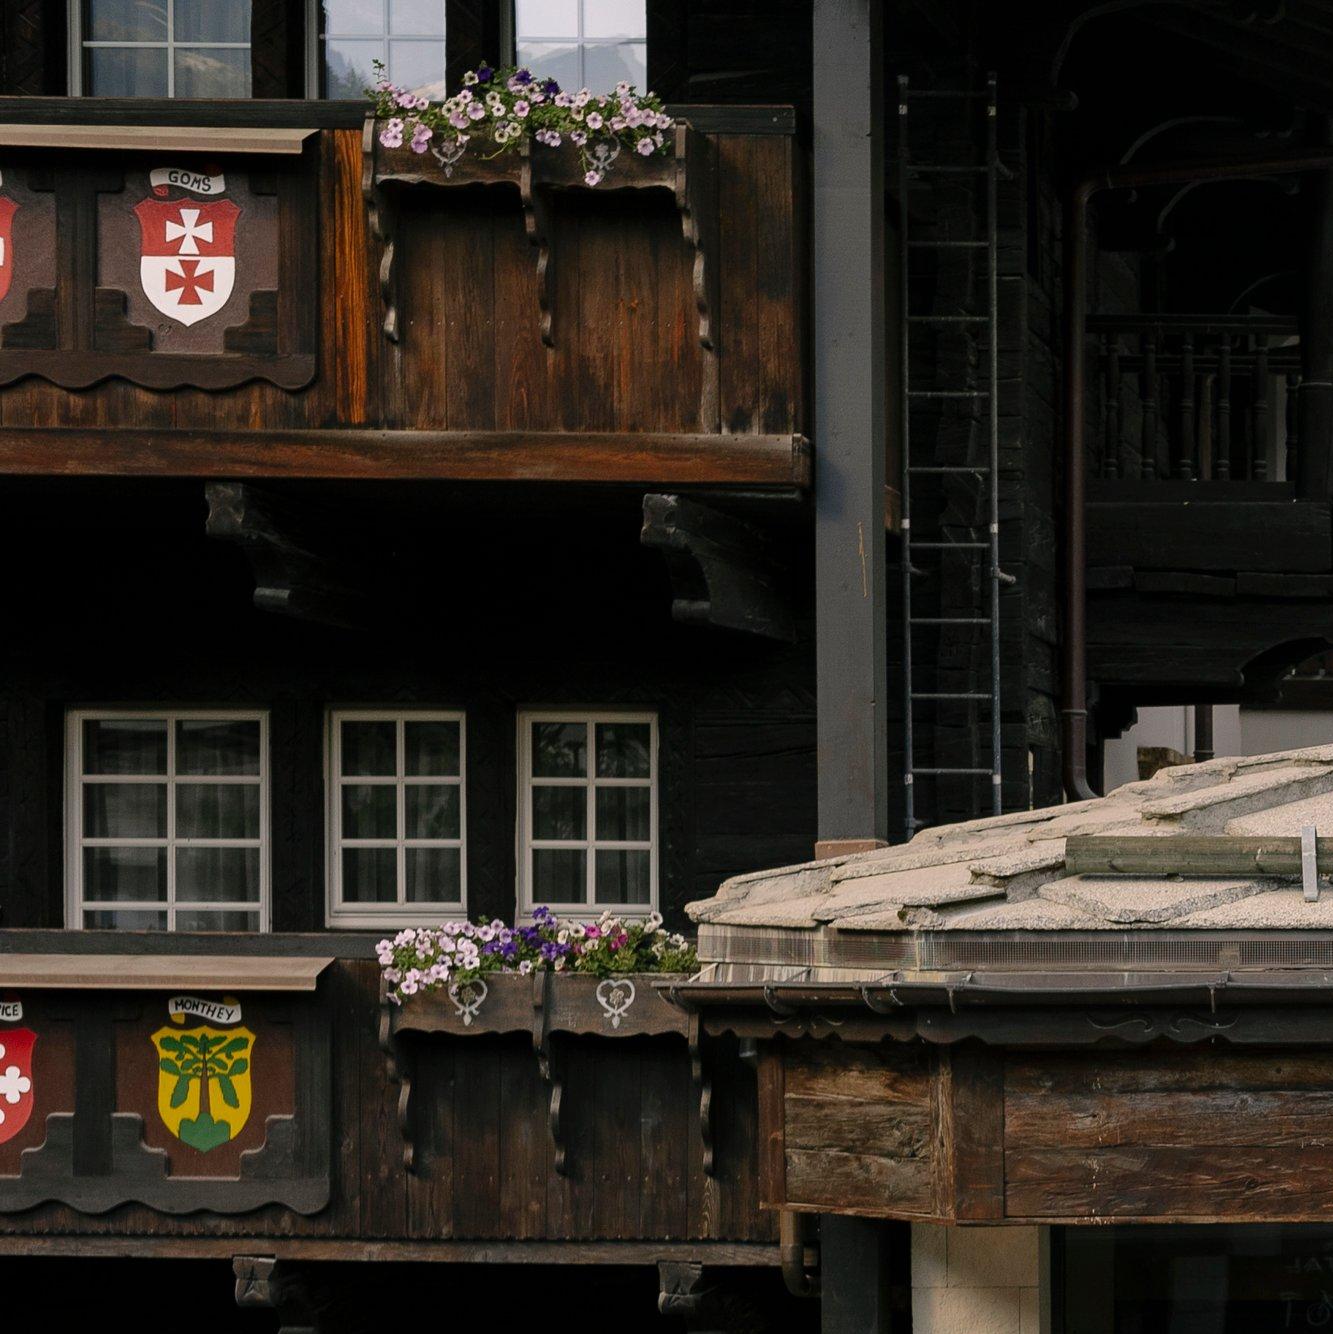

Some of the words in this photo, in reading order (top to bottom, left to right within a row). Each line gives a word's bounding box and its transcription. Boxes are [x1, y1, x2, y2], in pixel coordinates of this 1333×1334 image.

[169, 170, 211, 192] GOMS
[0, 1003, 19, 1017] ICE
[175, 998, 234, 1021] MONTHEY
